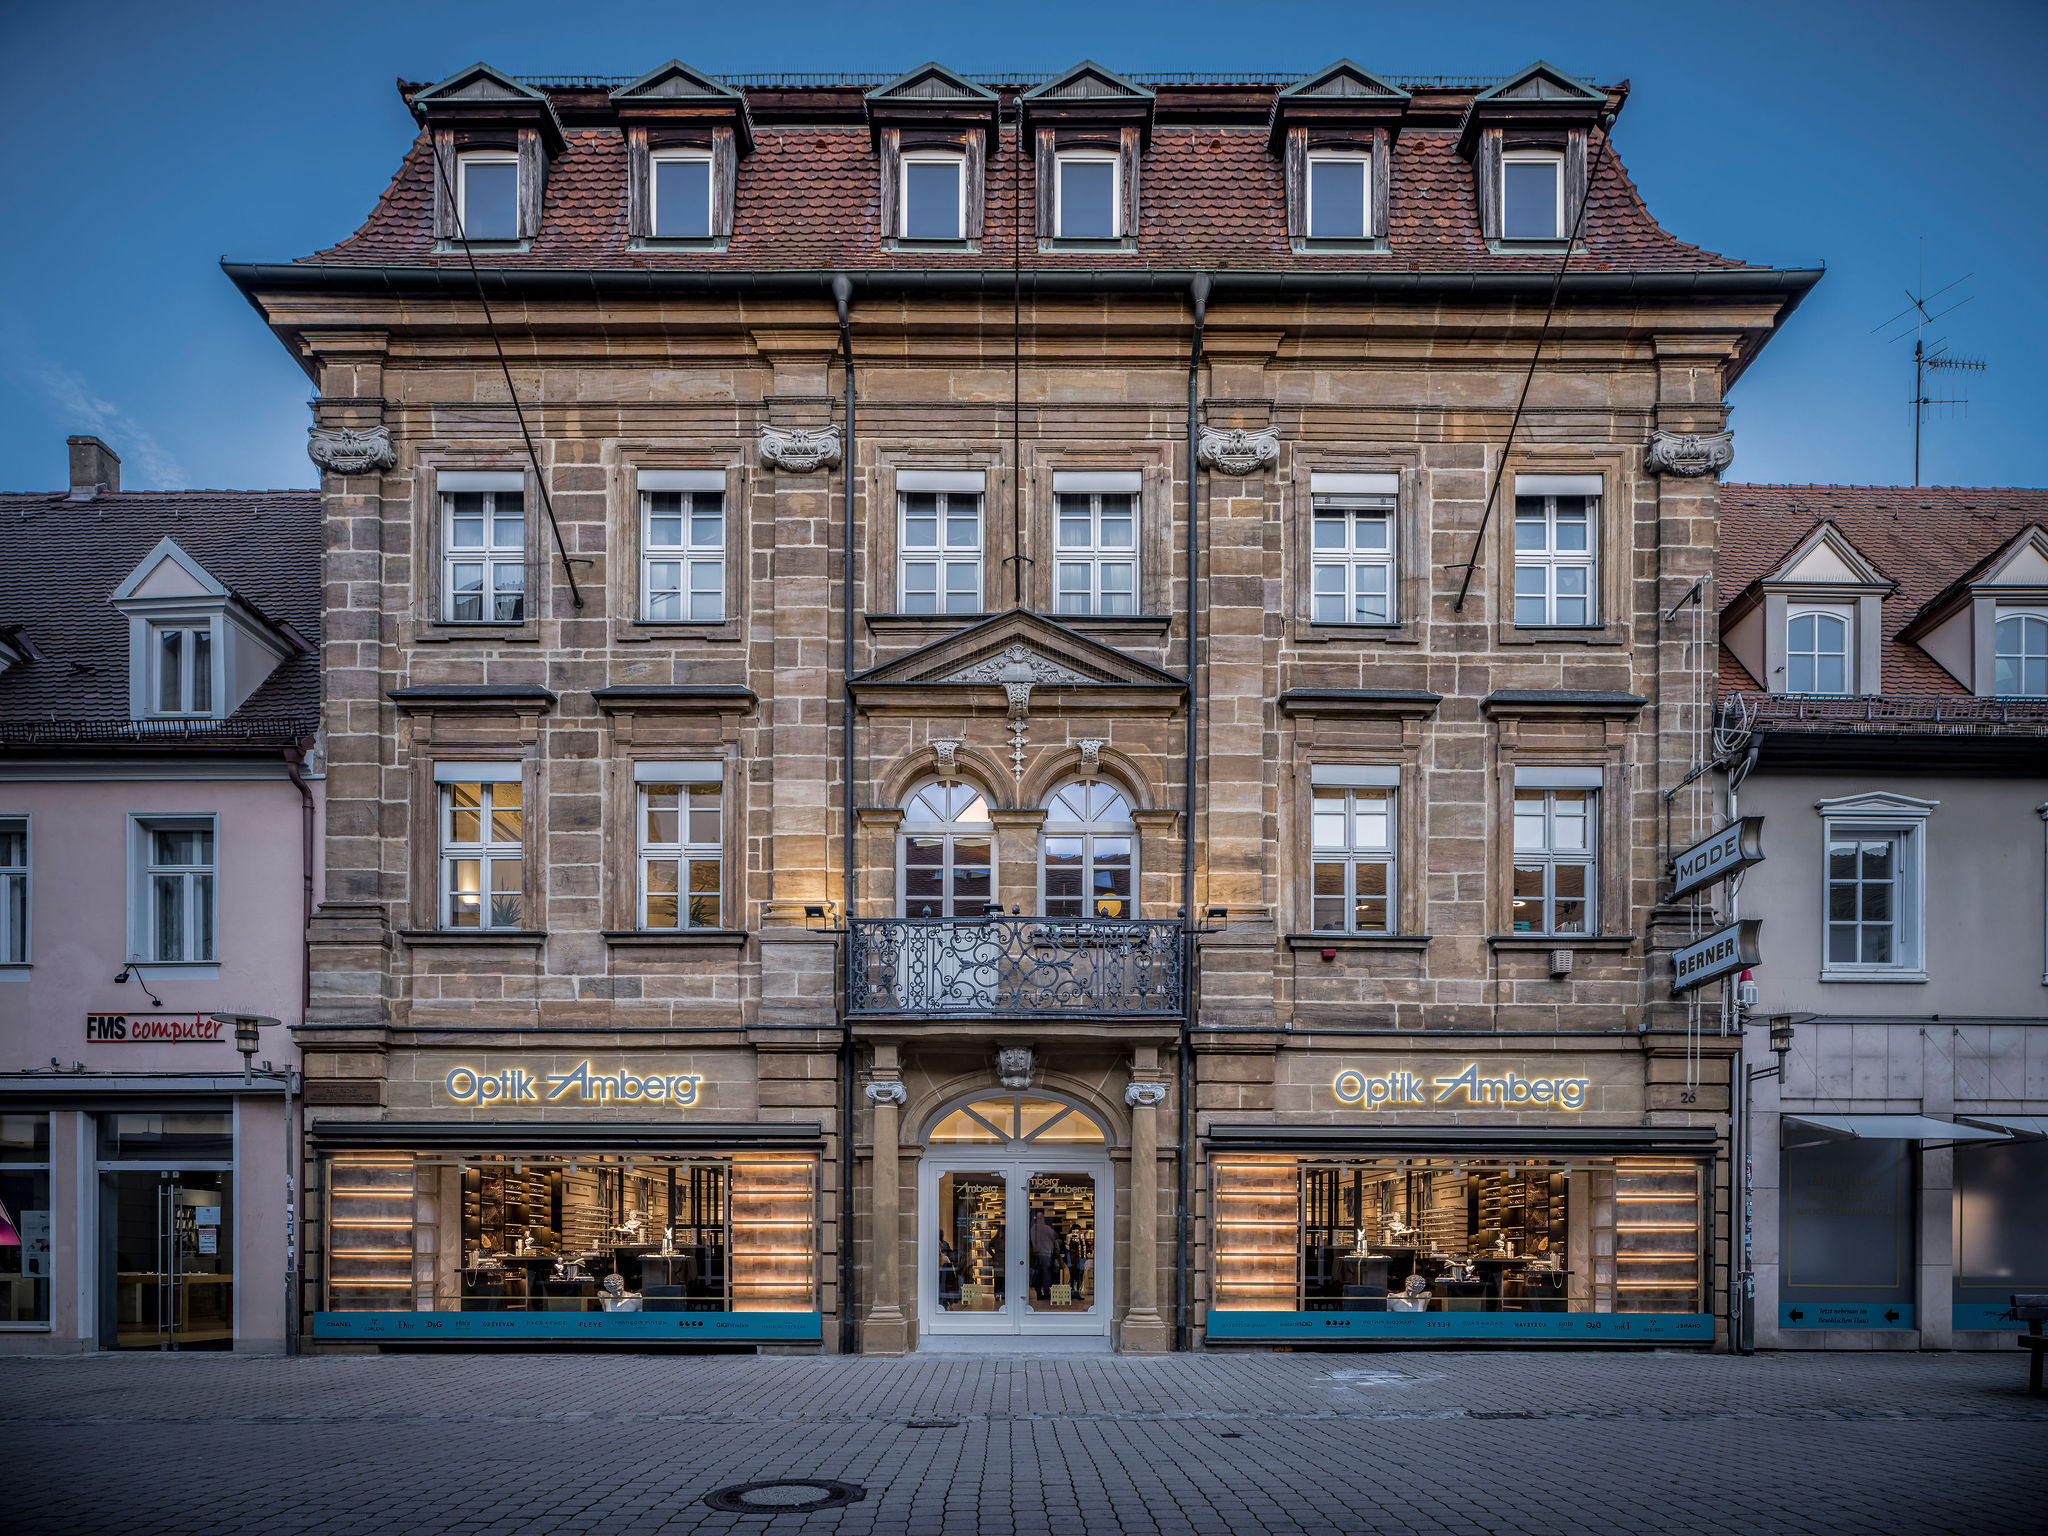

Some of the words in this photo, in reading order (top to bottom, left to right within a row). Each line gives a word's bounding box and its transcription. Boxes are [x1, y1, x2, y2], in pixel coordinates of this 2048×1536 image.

[1680, 836, 1737, 882] MODE
[1679, 937, 1734, 977] BERNER
[87, 1016, 126, 1040] FMS
[132, 1011, 224, 1045] computer
[446, 1068, 535, 1105] Optik
[547, 1060, 701, 1105] Amberg
[1335, 1070, 1425, 1108] Optik
[1436, 1063, 1590, 1109] Amberg
[1680, 1092, 1696, 1104] 26
[956, 1181, 999, 1194] Amberg
[1046, 1183, 1088, 1194] Amberg
